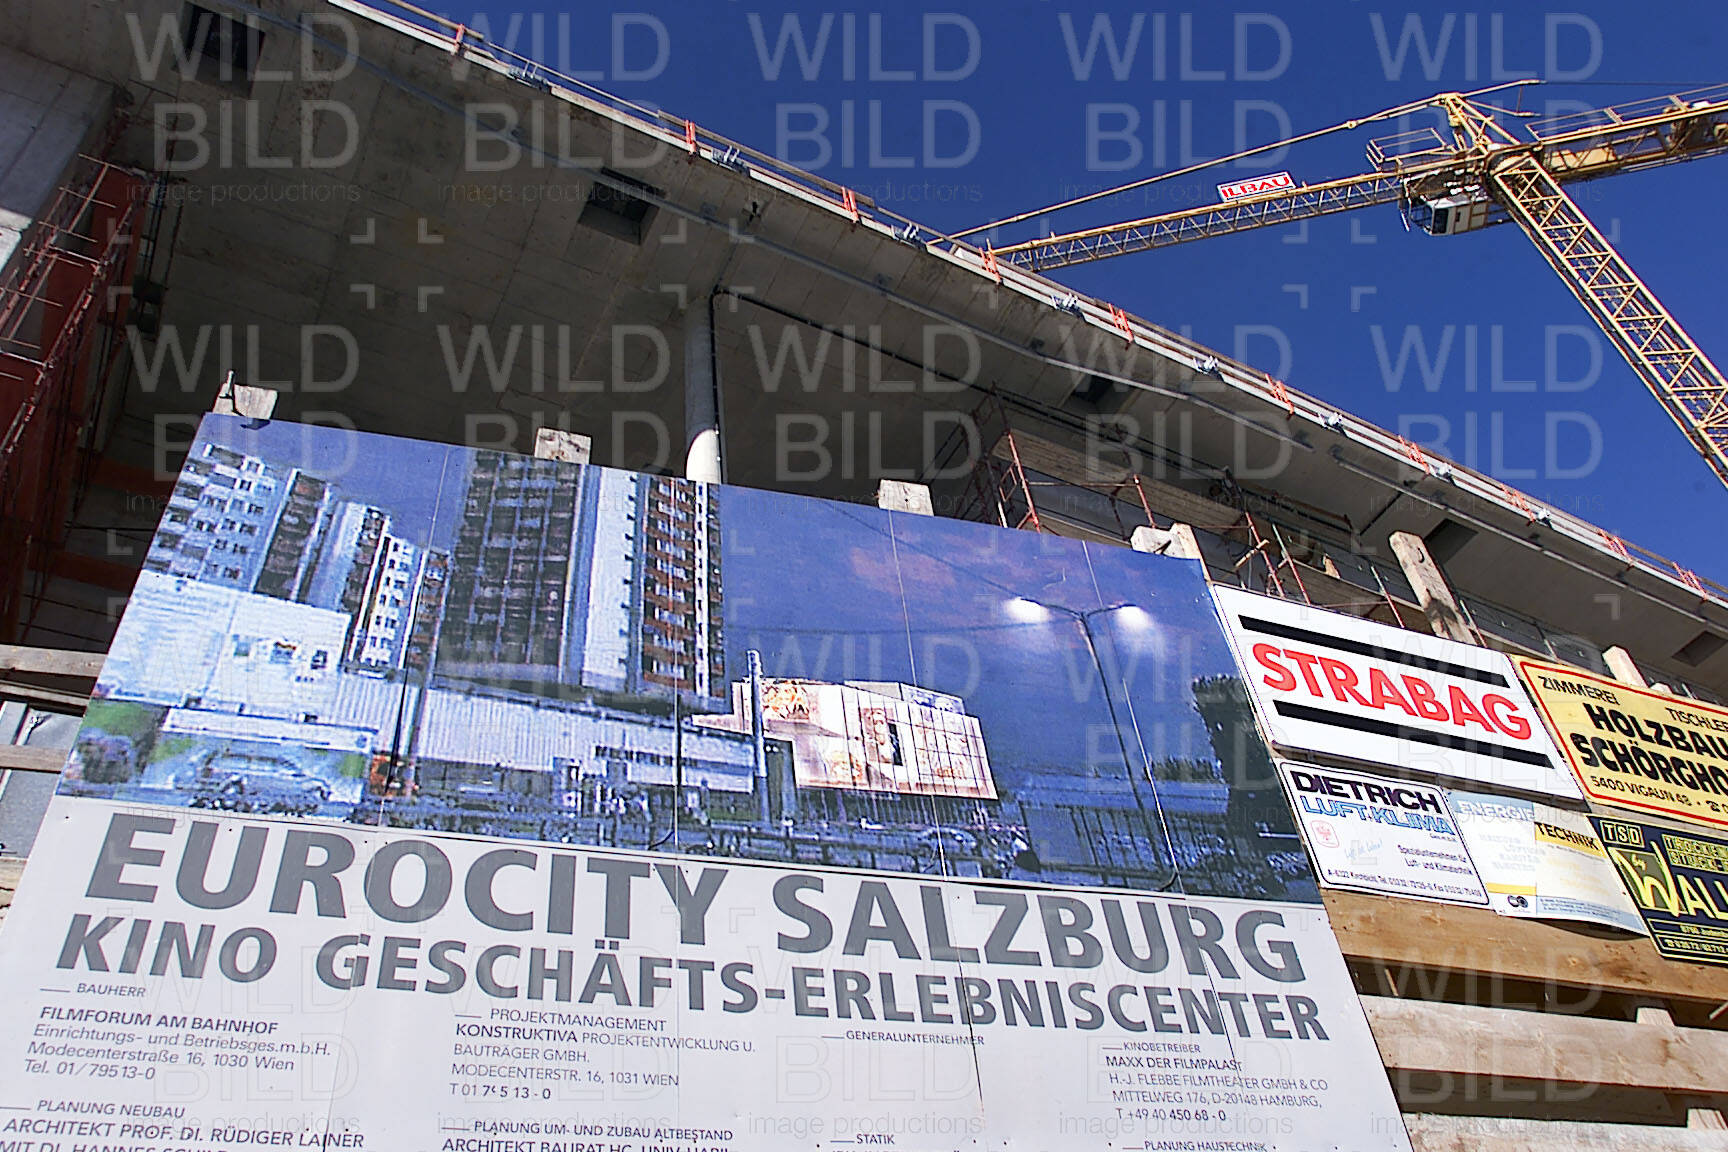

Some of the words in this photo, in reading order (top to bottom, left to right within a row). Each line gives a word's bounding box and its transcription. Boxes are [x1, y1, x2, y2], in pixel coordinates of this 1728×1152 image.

[1221, 176, 1290, 198] ILBAU
[1252, 642, 1531, 741] STRABAG
[1538, 676, 1620, 705] ZIMMEREI
[1583, 703, 1728, 761] HOLZBAU
[1570, 732, 1728, 796] SCHÖRGHO
[1290, 770, 1443, 814] DIETRICH
[1457, 800, 1535, 821] ENERGIE
[1534, 821, 1600, 850] TECHNIK
[1603, 823, 1641, 845] TSD
[85, 813, 729, 945] EUROCITY
[771, 874, 1305, 983] SALZBURG
[56, 913, 278, 983] KINO
[315, 932, 1329, 1041] GESCHÄFTS-ERLEBNISCENTER
[77, 982, 146, 998] BAUHERR
[40, 1006, 152, 1026] FILMFORUM
[156, 1014, 187, 1029] AM
[191, 1017, 279, 1035] BAHNHOF
[491, 1008, 667, 1031] PROJEKTMANAGEMENT
[34, 1023, 143, 1045] Einrichtungs-
[148, 1033, 179, 1046] und
[184, 1033, 331, 1056] Betriebsges.m.b.H.
[456, 1023, 578, 1043] KONSTRUKTIVA
[582, 1032, 739, 1052] PROJEKTENTWICKLUNG
[743, 1041, 756, 1052] U.
[846, 1030, 985, 1045] GENERALUNTERNEHMER
[1123, 1041, 1201, 1053] KINOBETREIBER
[25, 1059, 49, 1074] Tel.
[27, 1041, 179, 1063] Modecenterstraße
[186, 1052, 206, 1067] 16,
[214, 1053, 248, 1068] 1030
[255, 1056, 294, 1071] Wien
[1105, 1056, 1144, 1067] MAXX
[1146, 1057, 1171, 1069] DER
[1174, 1058, 1242, 1071] FILMPALAST
[451, 1063, 581, 1081] MODECENTERSTR.
[587, 1070, 604, 1084] 16,
[609, 1071, 639, 1084] 1031
[643, 1073, 679, 1086] WIEN
[1137, 1073, 1181, 1086] FLEBBE
[1183, 1074, 1259, 1090] FILMTHEATER
[1261, 1077, 1297, 1091] GMBH
[1300, 1079, 1308, 1090] &
[1310, 1079, 1328, 1091] CO
[450, 1083, 459, 1095] T
[461, 1084, 478, 1096] 01
[542, 1088, 551, 1100] 0
[1113, 1090, 1184, 1103] MITTELWEG
[37, 1099, 115, 1115] PLANUNG
[119, 1104, 186, 1118] NEUBAU
[1115, 1108, 1123, 1119] T
[1128, 1109, 1149, 1120] +49
[1152, 1109, 1166, 1120] 40
[1169, 1109, 1191, 1121] 450
[1194, 1109, 1209, 1121] 68
[1218, 1110, 1226, 1121] 0
[3, 1118, 115, 1137] ARCHITEKT
[119, 1124, 173, 1140] PROF.
[180, 1127, 203, 1141] DI.
[210, 1126, 293, 1145] RÜDIGER
[299, 1131, 364, 1148] LAINER
[474, 1120, 540, 1134] PLANUNG
[544, 1124, 570, 1135] UM-
[574, 1125, 603, 1137] UND
[607, 1126, 651, 1138] ZUBAU
[654, 1128, 733, 1141] ALTBESTAND
[856, 1134, 895, 1146] STATIK
[442, 1138, 536, 1152] ARCHITEKT
[1144, 1141, 1194, 1151] PLANUNG
